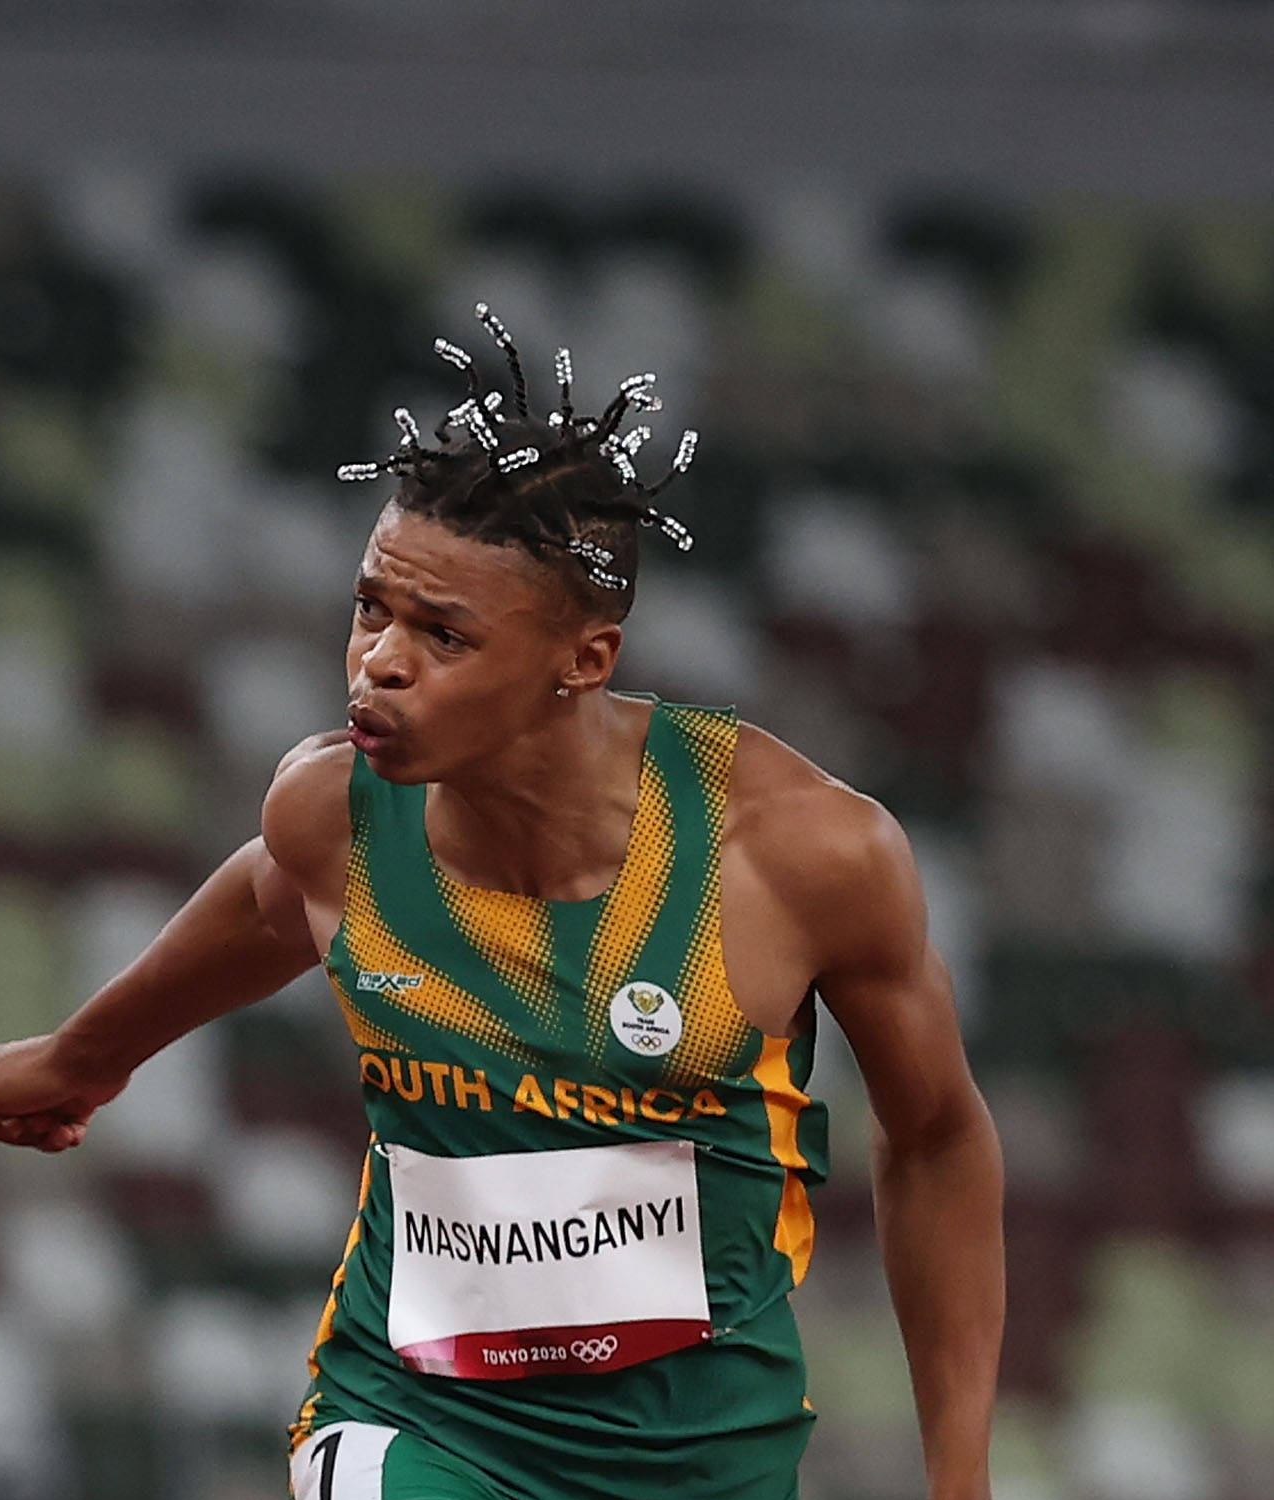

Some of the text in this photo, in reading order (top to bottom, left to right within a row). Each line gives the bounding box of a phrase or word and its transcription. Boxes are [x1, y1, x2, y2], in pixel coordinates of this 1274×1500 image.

[359, 1052, 727, 1126] OUTH AFRICA
[405, 1196, 686, 1265] MASWANGANYI
[482, 1346, 567, 1365] TOKYO 2020
